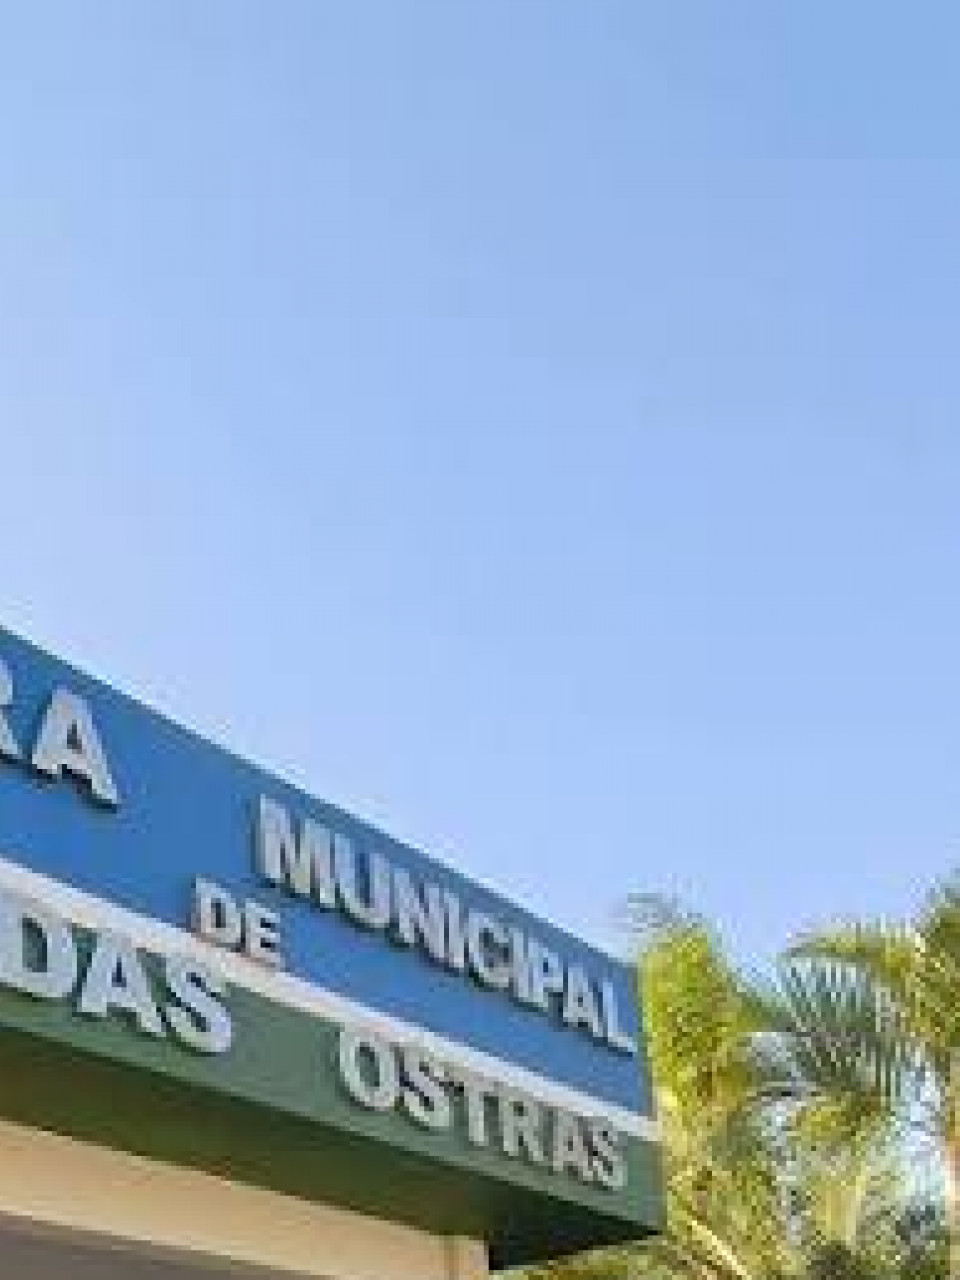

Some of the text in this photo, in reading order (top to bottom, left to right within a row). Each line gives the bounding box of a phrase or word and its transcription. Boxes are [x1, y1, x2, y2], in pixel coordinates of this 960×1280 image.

[192, 876, 283, 972] DE
[255, 793, 635, 1055] MUNICIPAL
[337, 1020, 628, 1190] OSTRAS
